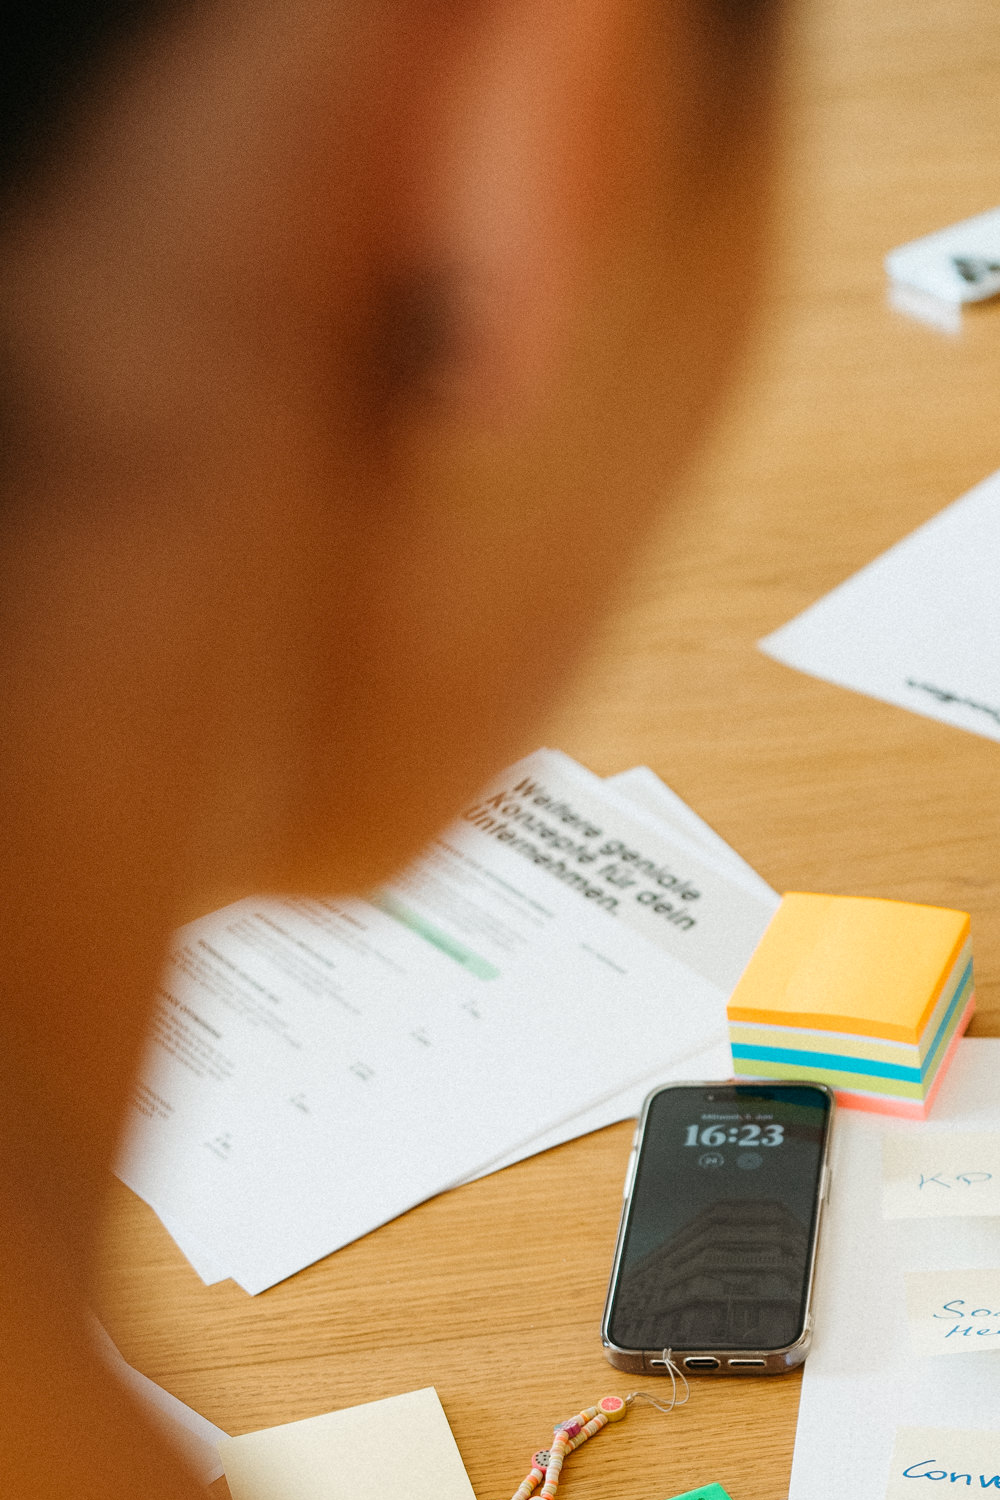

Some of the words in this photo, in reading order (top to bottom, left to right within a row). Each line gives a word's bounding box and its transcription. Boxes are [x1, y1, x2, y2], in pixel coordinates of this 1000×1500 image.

[486, 790, 597, 866] Konzepte
[599, 862, 637, 892] für
[636, 888, 697, 933] dein
[512, 777, 602, 842] Weitere
[600, 838, 701, 904] geniale
[684, 1123, 785, 1147] 16:23
